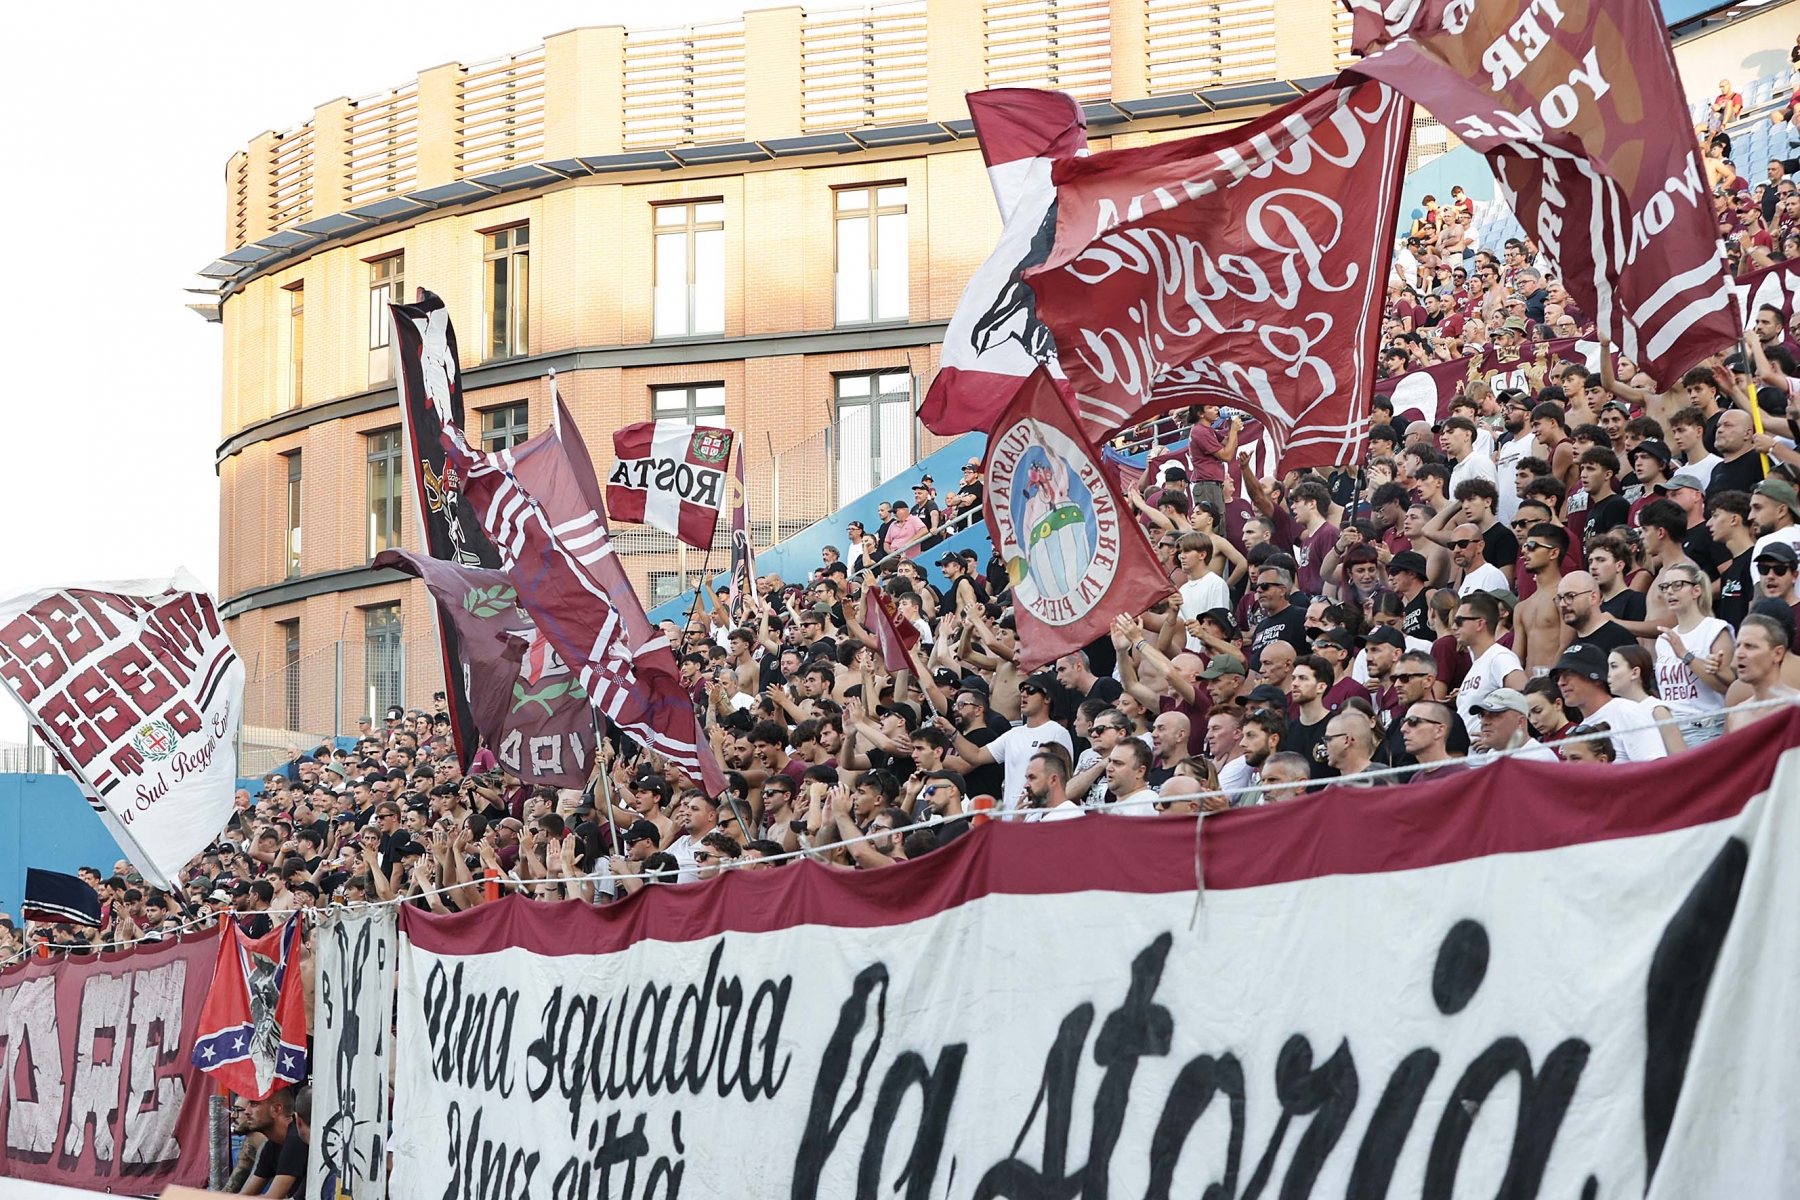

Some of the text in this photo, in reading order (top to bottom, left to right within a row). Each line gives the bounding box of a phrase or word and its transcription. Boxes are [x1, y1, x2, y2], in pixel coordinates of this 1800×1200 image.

[135, 772, 170, 811] Sud
[171, 733, 217, 784] Reggio
[424, 958, 519, 1099] Una
[526, 937, 793, 1140] squadra
